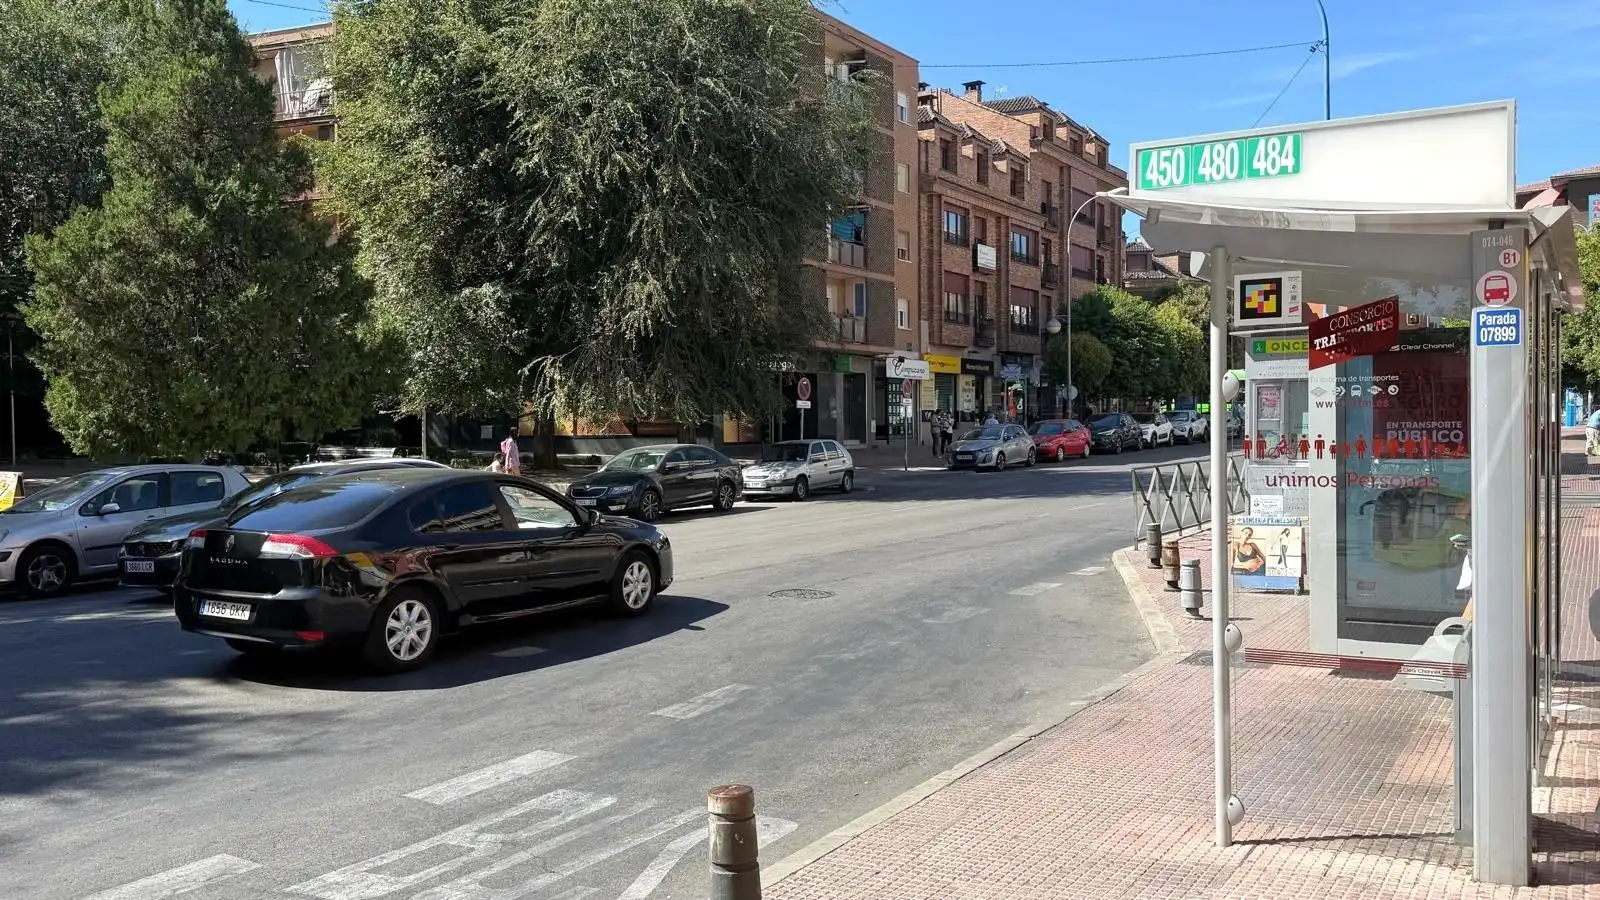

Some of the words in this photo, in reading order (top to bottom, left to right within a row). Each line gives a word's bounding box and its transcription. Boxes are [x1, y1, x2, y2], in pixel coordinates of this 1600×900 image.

[1145, 148, 1186, 186] 450
[1198, 142, 1240, 182] 480
[1252, 135, 1295, 176] 484
[1503, 252, 1517, 264] B1
[1329, 301, 1394, 331] CONSORCIO
[1480, 312, 1517, 326] Parada
[1480, 326, 1517, 342] 07899
[1271, 341, 1309, 352] ONCE
[1401, 343, 1422, 351] Clear
[1422, 342, 1456, 350] Channel
[1359, 374, 1399, 383] transportes
[1386, 421, 1399, 429] EN
[1401, 420, 1463, 429] TRANSPORTE
[1264, 472, 1338, 488] unimos
[1346, 472, 1440, 488] Personas
